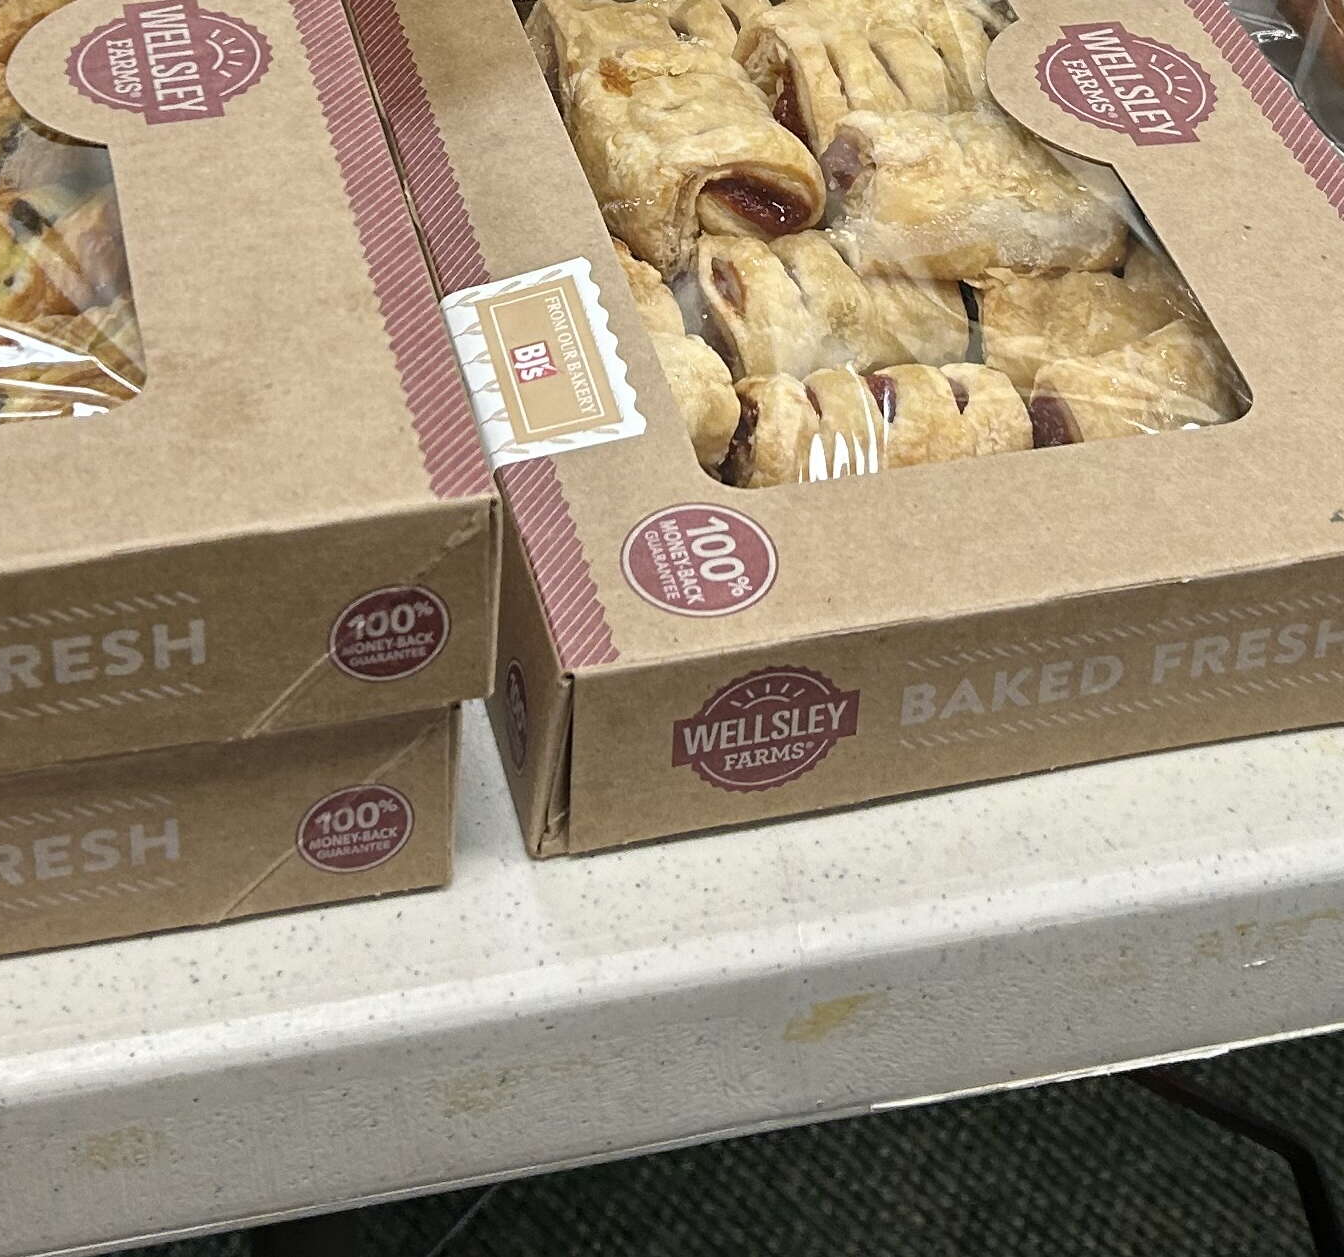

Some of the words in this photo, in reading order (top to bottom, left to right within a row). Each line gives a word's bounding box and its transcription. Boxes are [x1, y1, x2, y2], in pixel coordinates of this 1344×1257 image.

[139, 5, 208, 112] WELLSLEY
[1077, 28, 1182, 136] WELLSLEY
[544, 296, 568, 335] FROM
[555, 330, 579, 364] OUR
[565, 360, 599, 417] BAKERY
[643, 529, 681, 601] GUARANTEE
[658, 517, 705, 605] MONEY-BACK
[686, 516, 754, 599] 100%
[347, 601, 434, 641] 100%
[349, 646, 427, 667] GUARANTEE
[900, 655, 1123, 727] BAKED
[681, 699, 850, 758] WELLSLEY
[309, 826, 398, 850] MONEY-BACK
[314, 798, 399, 834] 100%
[316, 840, 392, 860] GUARANTEE
